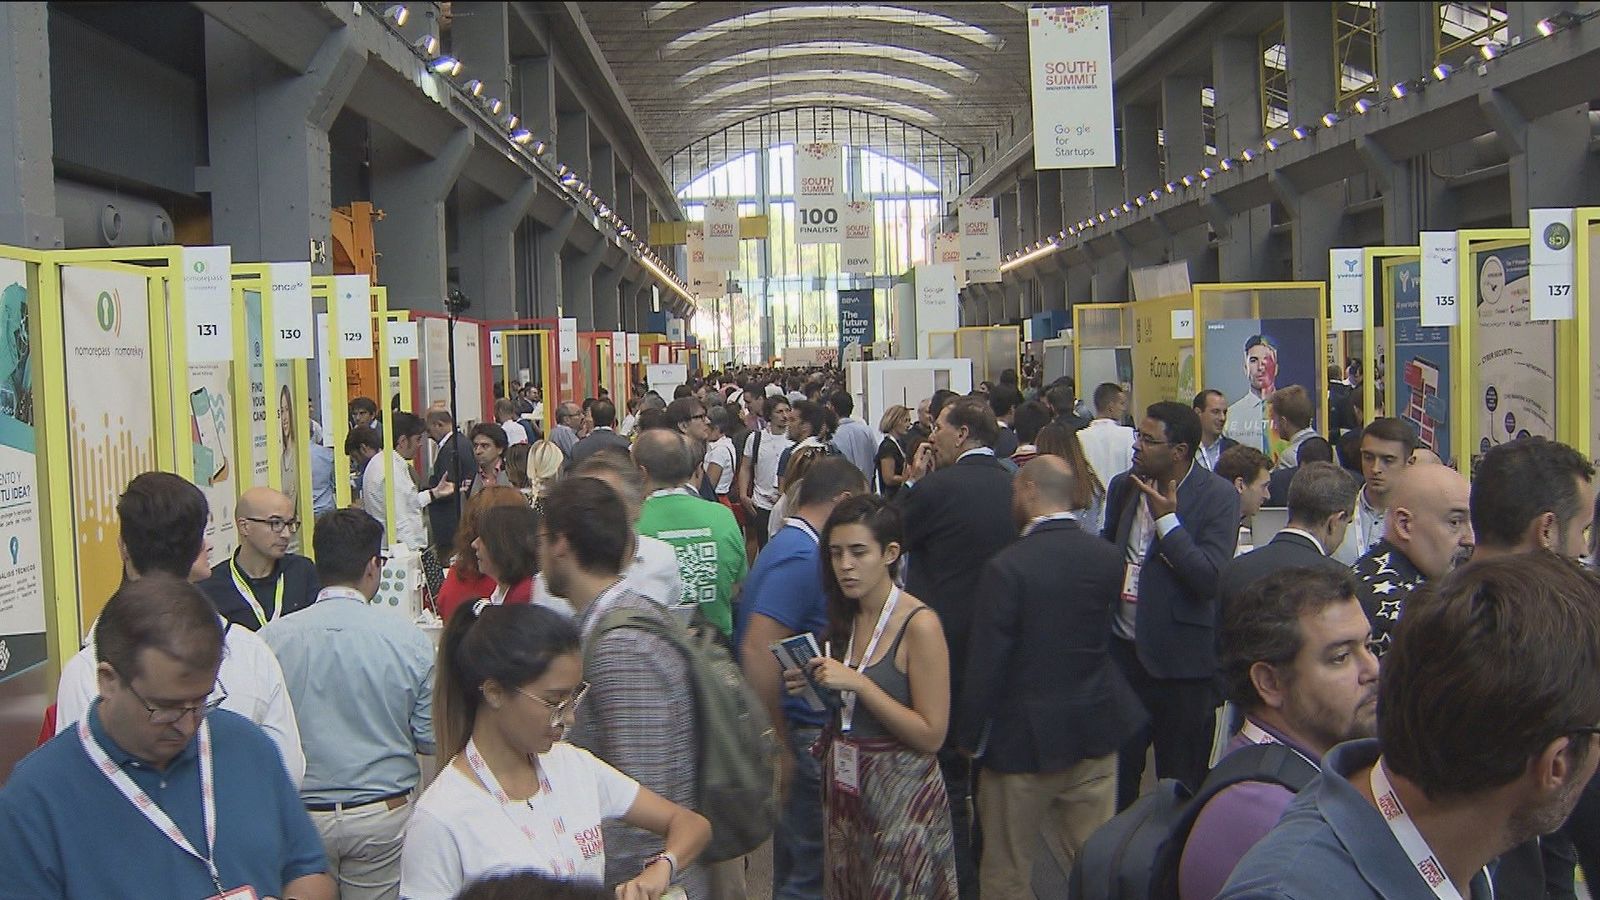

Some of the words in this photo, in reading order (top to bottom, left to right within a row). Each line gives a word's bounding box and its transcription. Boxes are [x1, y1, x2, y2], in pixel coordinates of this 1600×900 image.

[1045, 61, 1097, 74] SOUTH
[1046, 73, 1097, 85] SUMMIT
[1055, 124, 1090, 136] Google
[1056, 136, 1069, 145] for
[1056, 147, 1095, 158] Startups
[802, 178, 834, 186] SOUTH
[800, 208, 838, 225] 100
[1549, 285, 1570, 296] 137
[1436, 296, 1455, 306] 135
[1343, 305, 1359, 313] 133
[842, 311, 858, 319] The
[842, 318, 869, 327] future
[197, 325, 218, 336] 131
[281, 329, 301, 339] 130
[842, 326, 851, 334] is
[345, 333, 362, 341] 129
[393, 336, 409, 344] 128
[842, 335, 860, 343] now
[74, 346, 111, 358] nomorepass
[115, 345, 144, 359] nomorekey
[16, 471, 21, 482] Y
[1, 489, 10, 501] TU
[11, 484, 31, 499] IDEA?
[1380, 796, 1394, 820] SOUTH
[1417, 861, 1438, 888] SOUTH
[1425, 858, 1443, 883] SUMMIT
